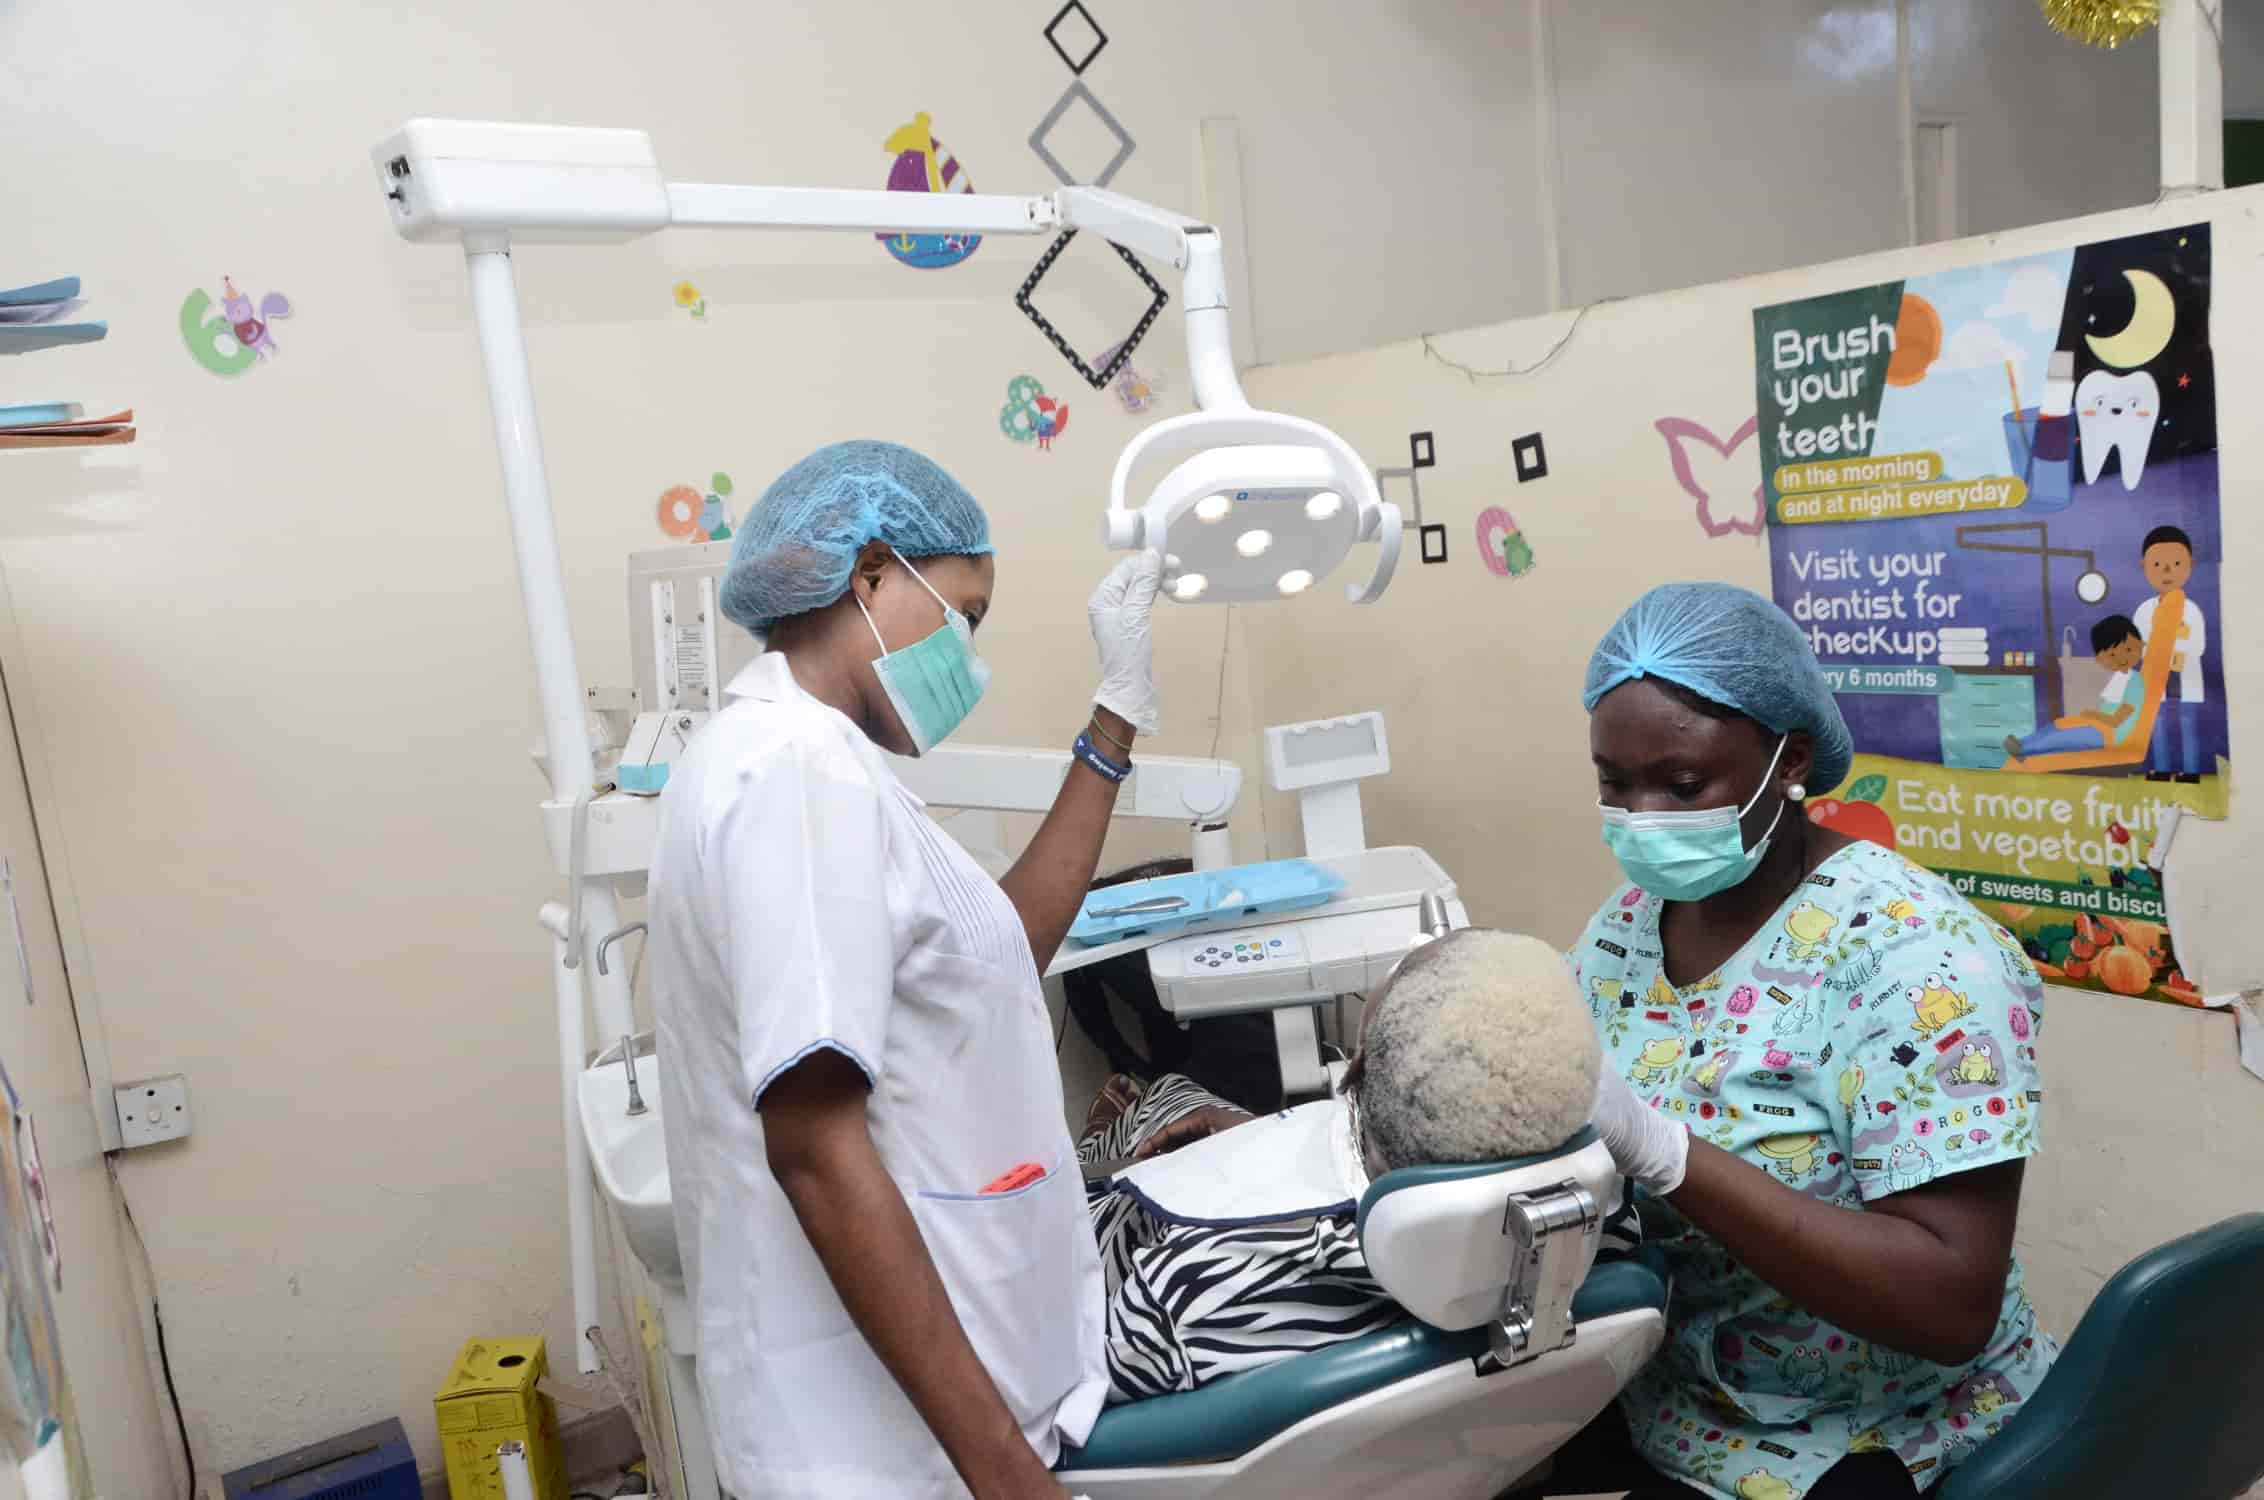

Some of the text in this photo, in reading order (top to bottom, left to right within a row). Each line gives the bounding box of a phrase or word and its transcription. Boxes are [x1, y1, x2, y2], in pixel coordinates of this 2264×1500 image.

[1773, 313, 1897, 370] Brush
[1774, 366, 1866, 417] your
[1777, 411, 1886, 459] teeth
[1782, 456, 1929, 488] in the morning
[1784, 480, 2011, 517] and at night everyday
[1789, 549, 1947, 587] Visit your
[1793, 579, 1962, 621] dentist for
[1850, 668, 1861, 686] 6
[1865, 668, 1937, 688] months
[1896, 778, 1965, 815] Eat
[1973, 792, 2073, 823] more
[1896, 819, 1961, 852] and
[1955, 874, 1977, 894] of
[1980, 880, 2055, 904] sweets
[2059, 889, 2101, 909] and
